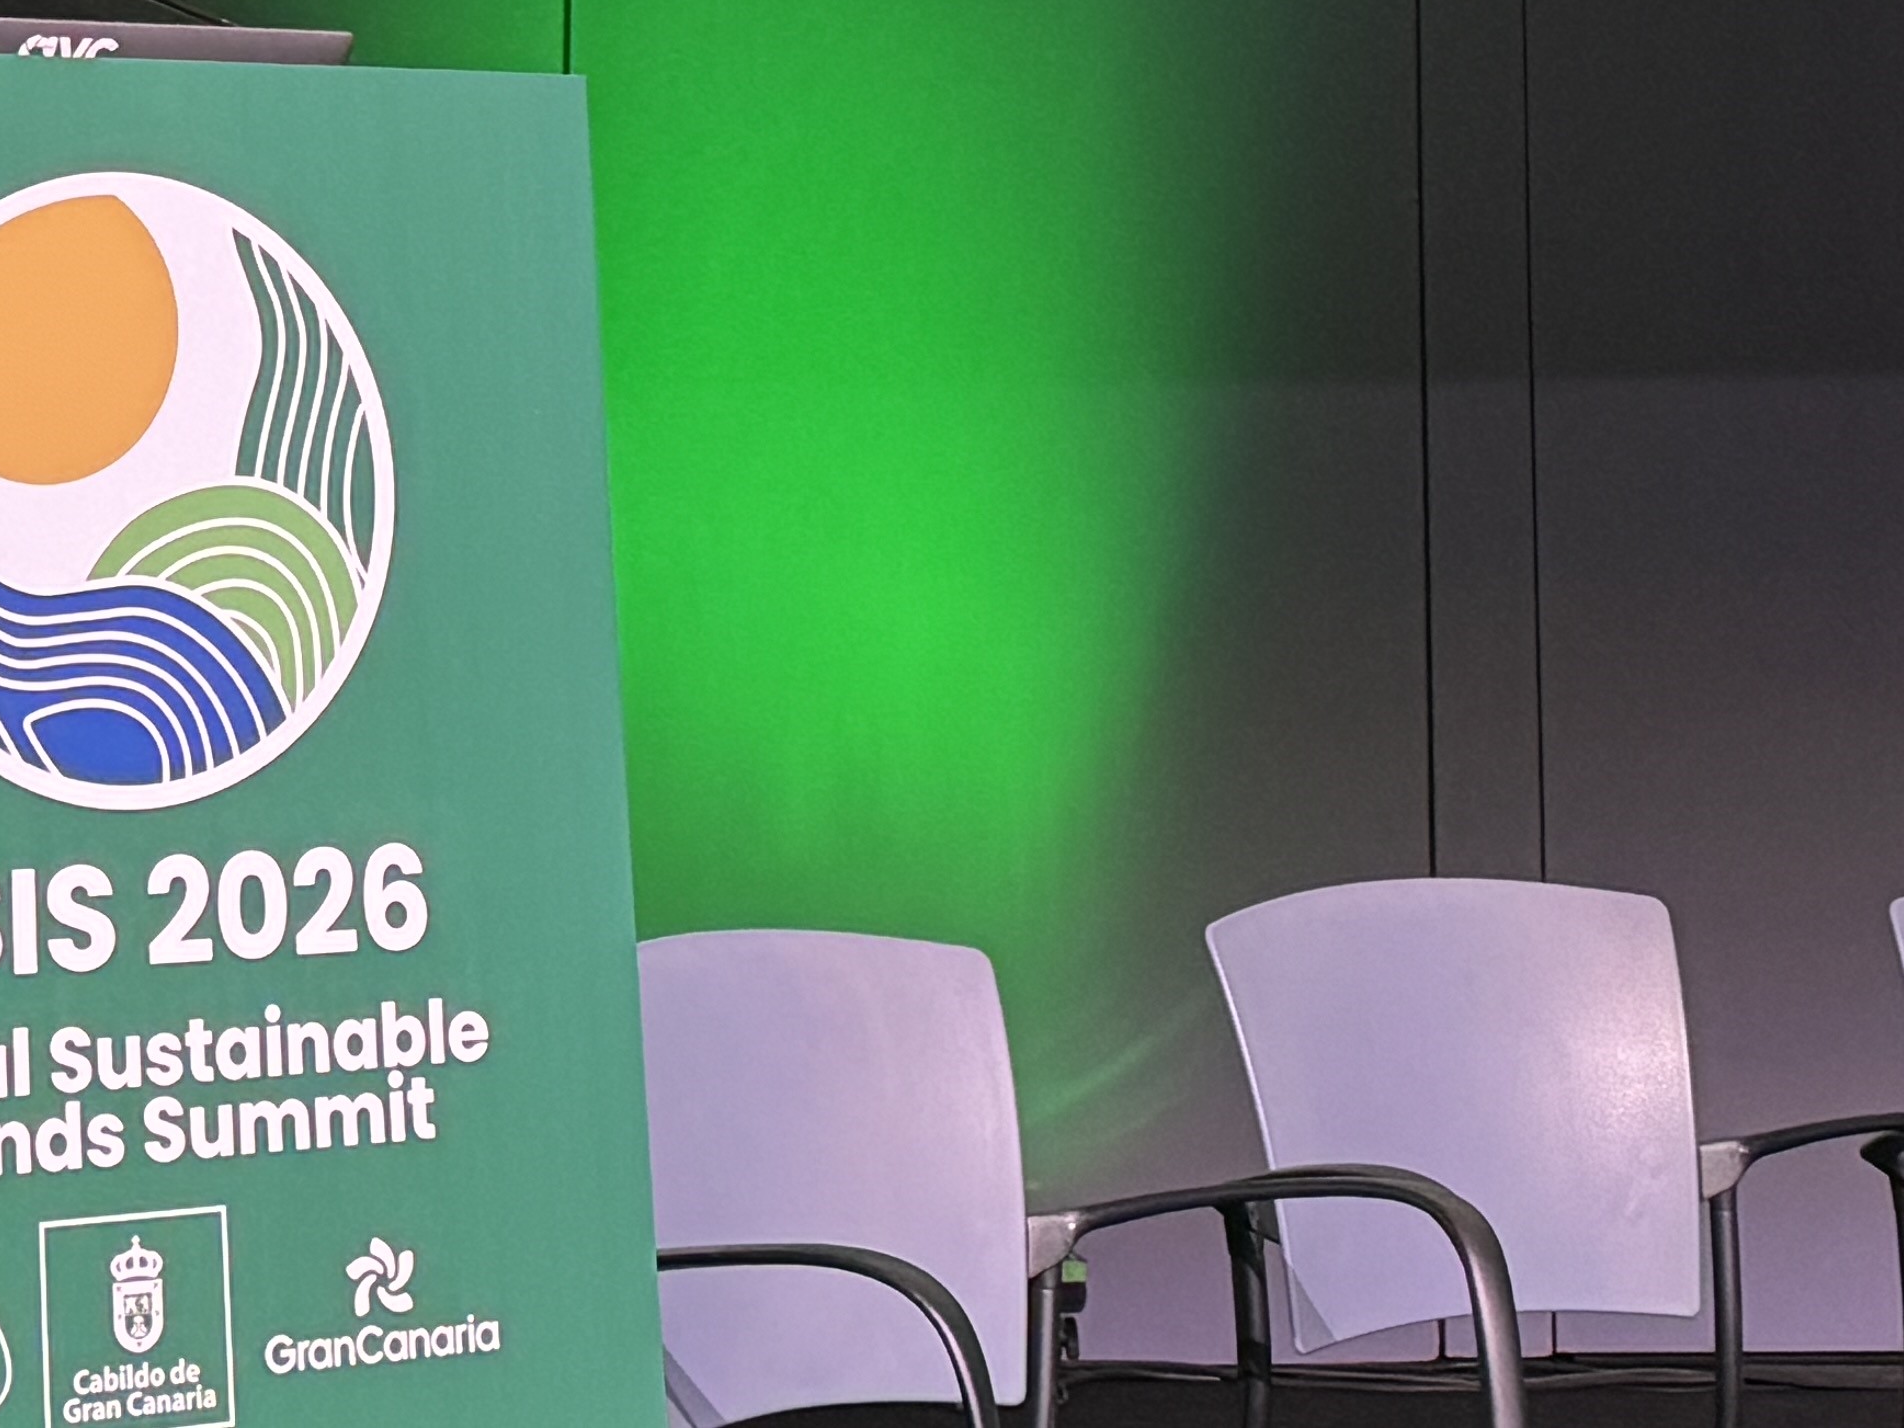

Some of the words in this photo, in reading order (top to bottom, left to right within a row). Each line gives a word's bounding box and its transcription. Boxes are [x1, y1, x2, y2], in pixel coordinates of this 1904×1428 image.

[147, 842, 428, 965] 2026
[49, 997, 489, 1094] Sustainable
[143, 1072, 436, 1163] Summit
[72, 1361, 166, 1396] Cabildo
[169, 1357, 201, 1385] de
[264, 1313, 501, 1375] GranCanaria
[62, 1397, 122, 1424] Gran
[126, 1383, 217, 1417] Canaria
